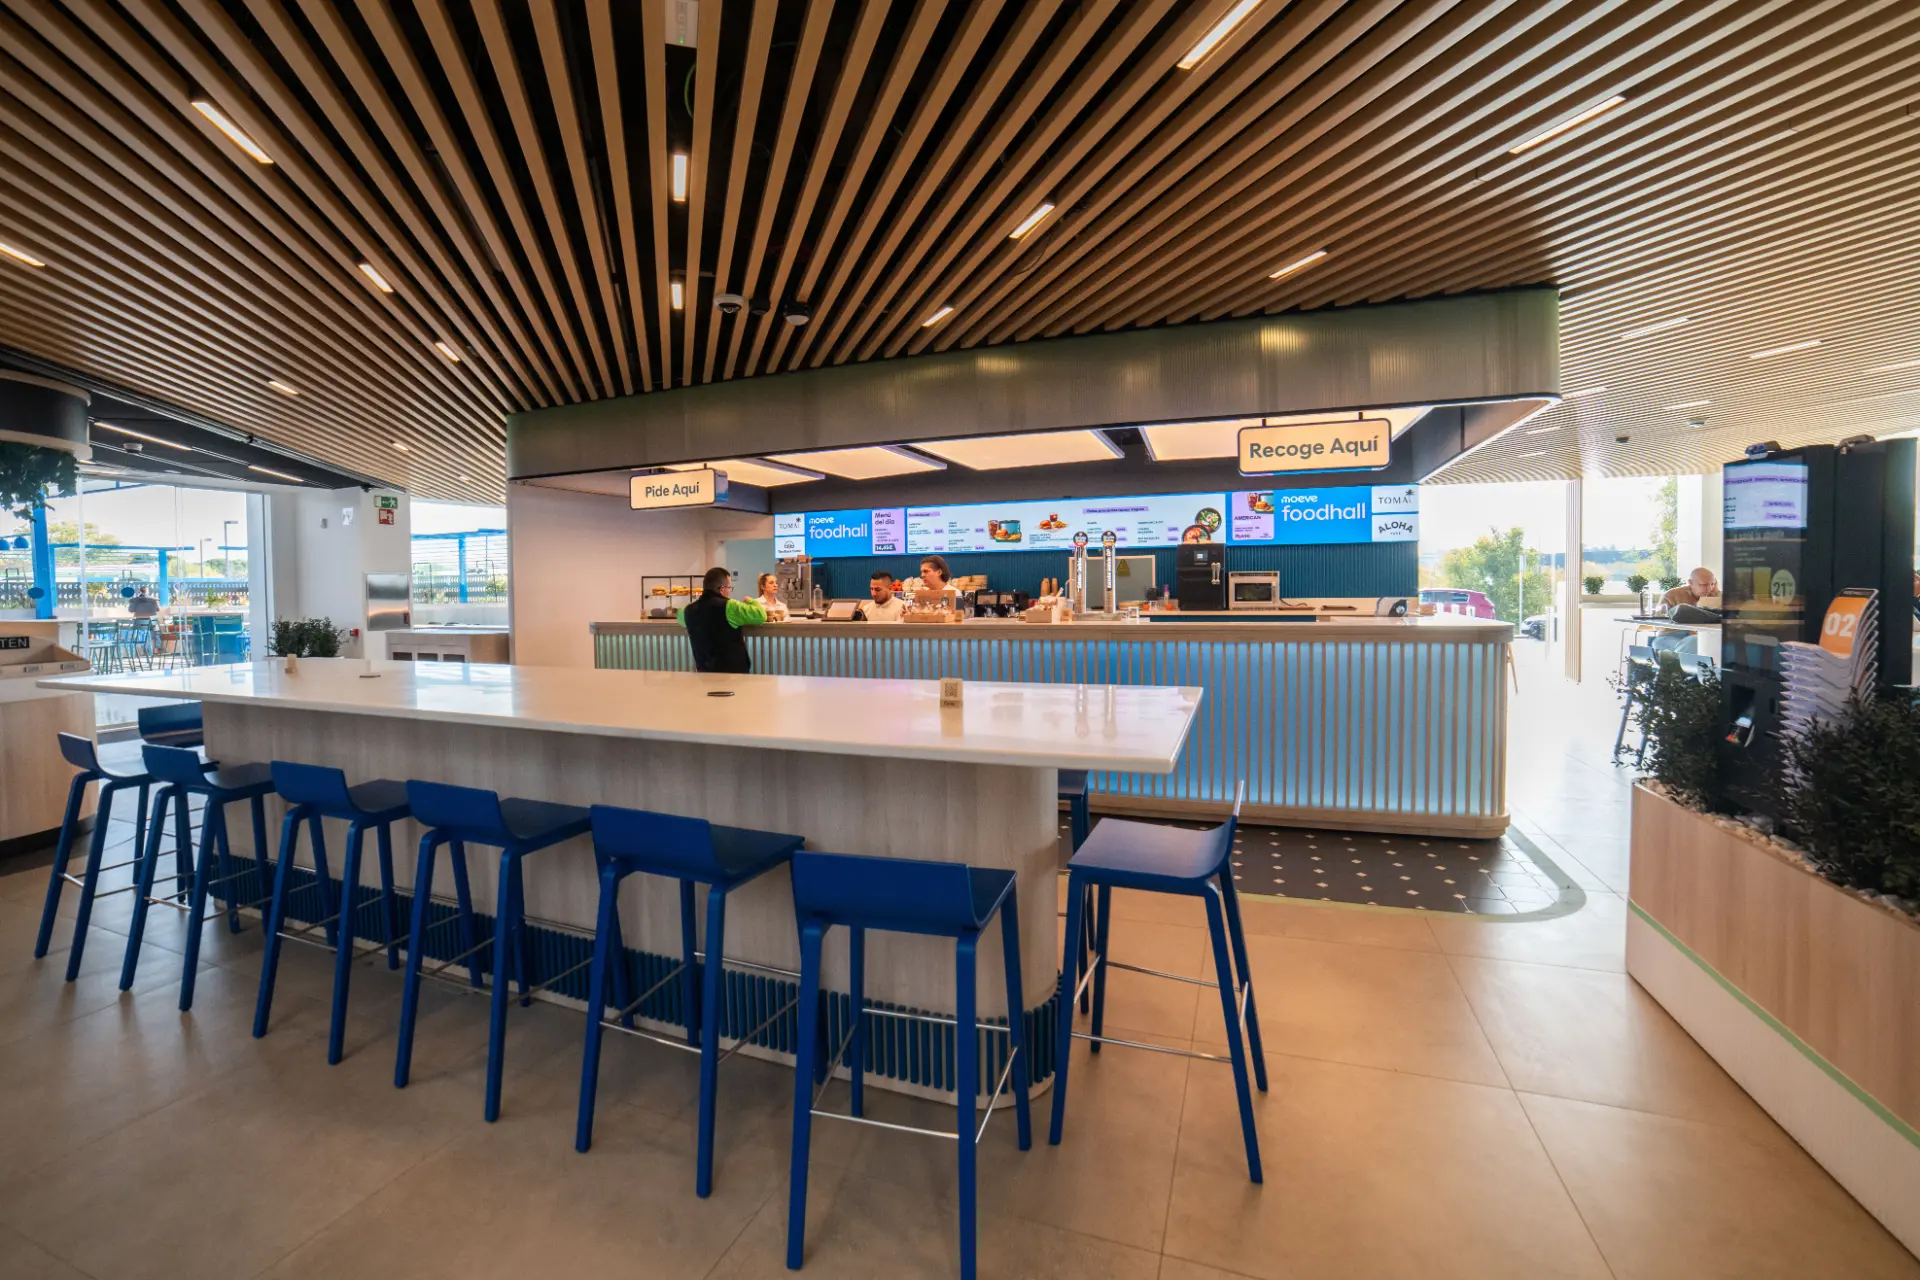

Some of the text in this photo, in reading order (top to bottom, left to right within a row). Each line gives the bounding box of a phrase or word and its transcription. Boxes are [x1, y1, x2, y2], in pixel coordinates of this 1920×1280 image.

[1250, 435, 1379, 460] Recoge Aquí
[645, 482, 700, 498] Pide Aquí
[1281, 495, 1318, 504] moeve
[1282, 503, 1366, 521] foodhall
[809, 517, 835, 525] moeve
[1378, 521, 1414, 534] ALOHA
[810, 524, 868, 539] foodhall
[1825, 612, 1856, 637] 02
